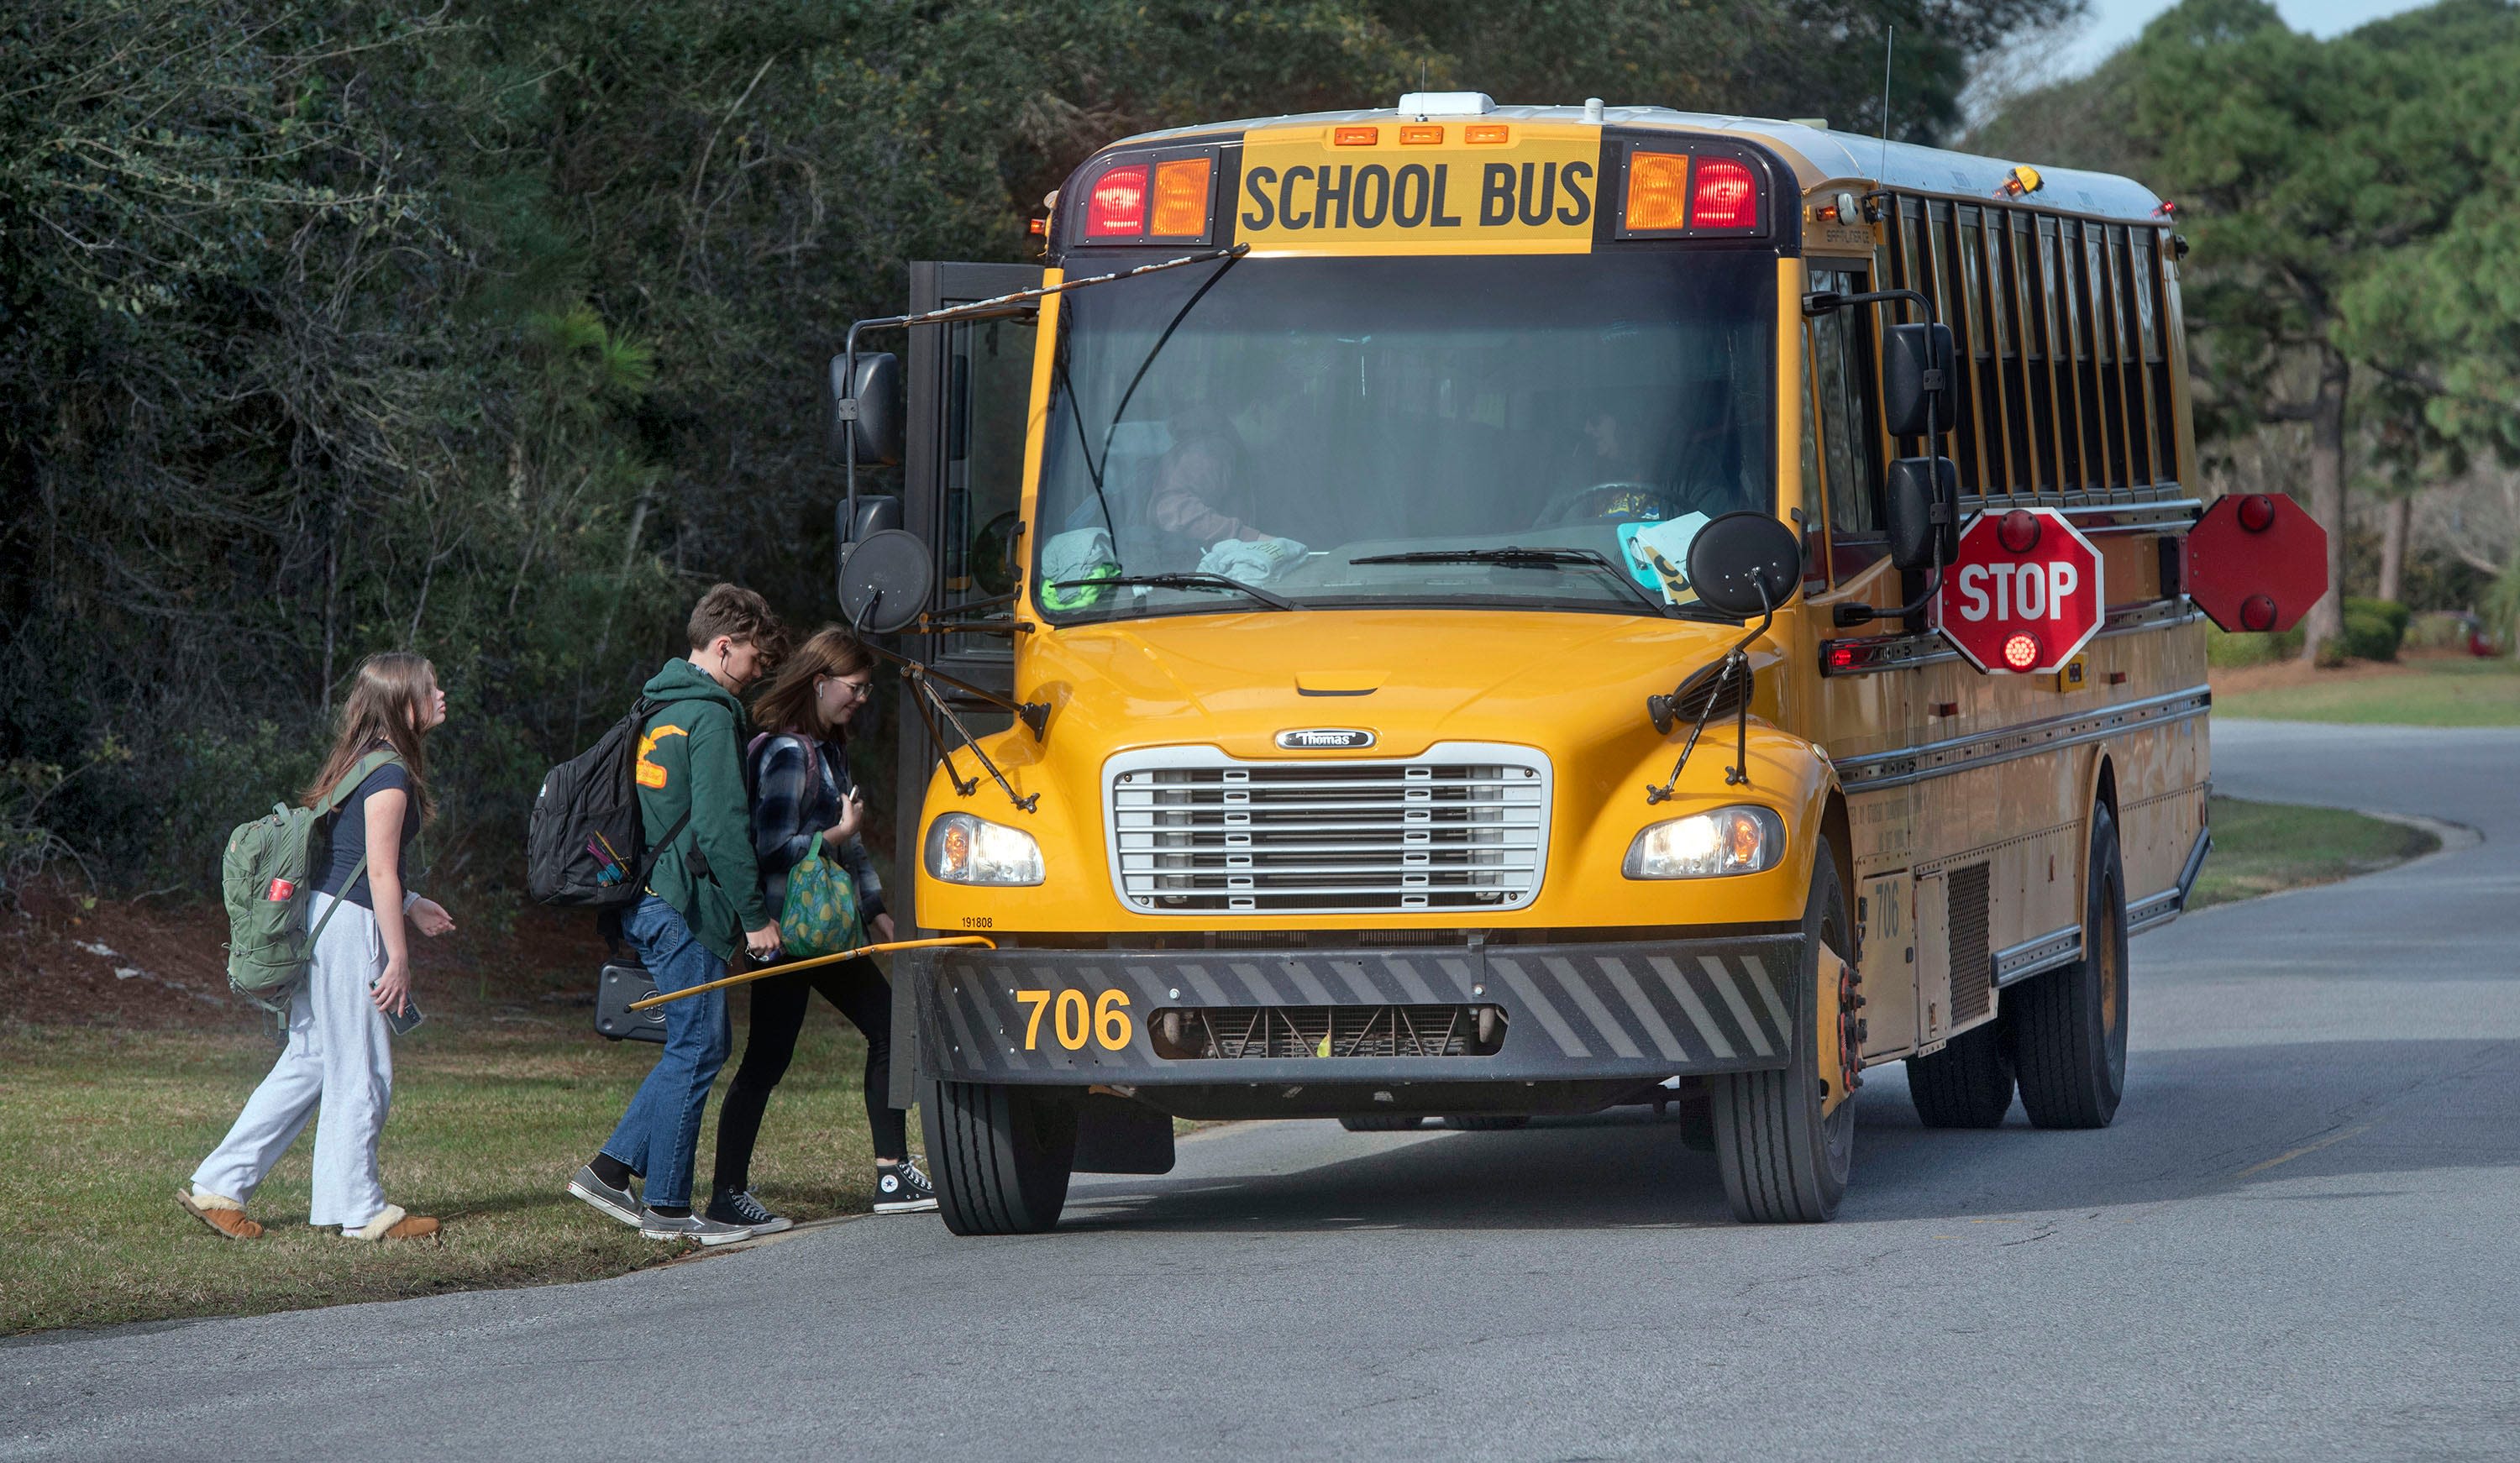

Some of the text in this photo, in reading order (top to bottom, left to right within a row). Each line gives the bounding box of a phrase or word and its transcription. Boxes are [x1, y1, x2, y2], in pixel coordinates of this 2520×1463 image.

[1242, 160, 1593, 231] SCHOOL BUS
[1960, 561, 2078, 621] STOP
[1296, 732, 1356, 745] Thomas
[961, 916, 993, 929] 191808
[1876, 880, 1898, 940] 706
[1016, 988, 1133, 1051] 706
